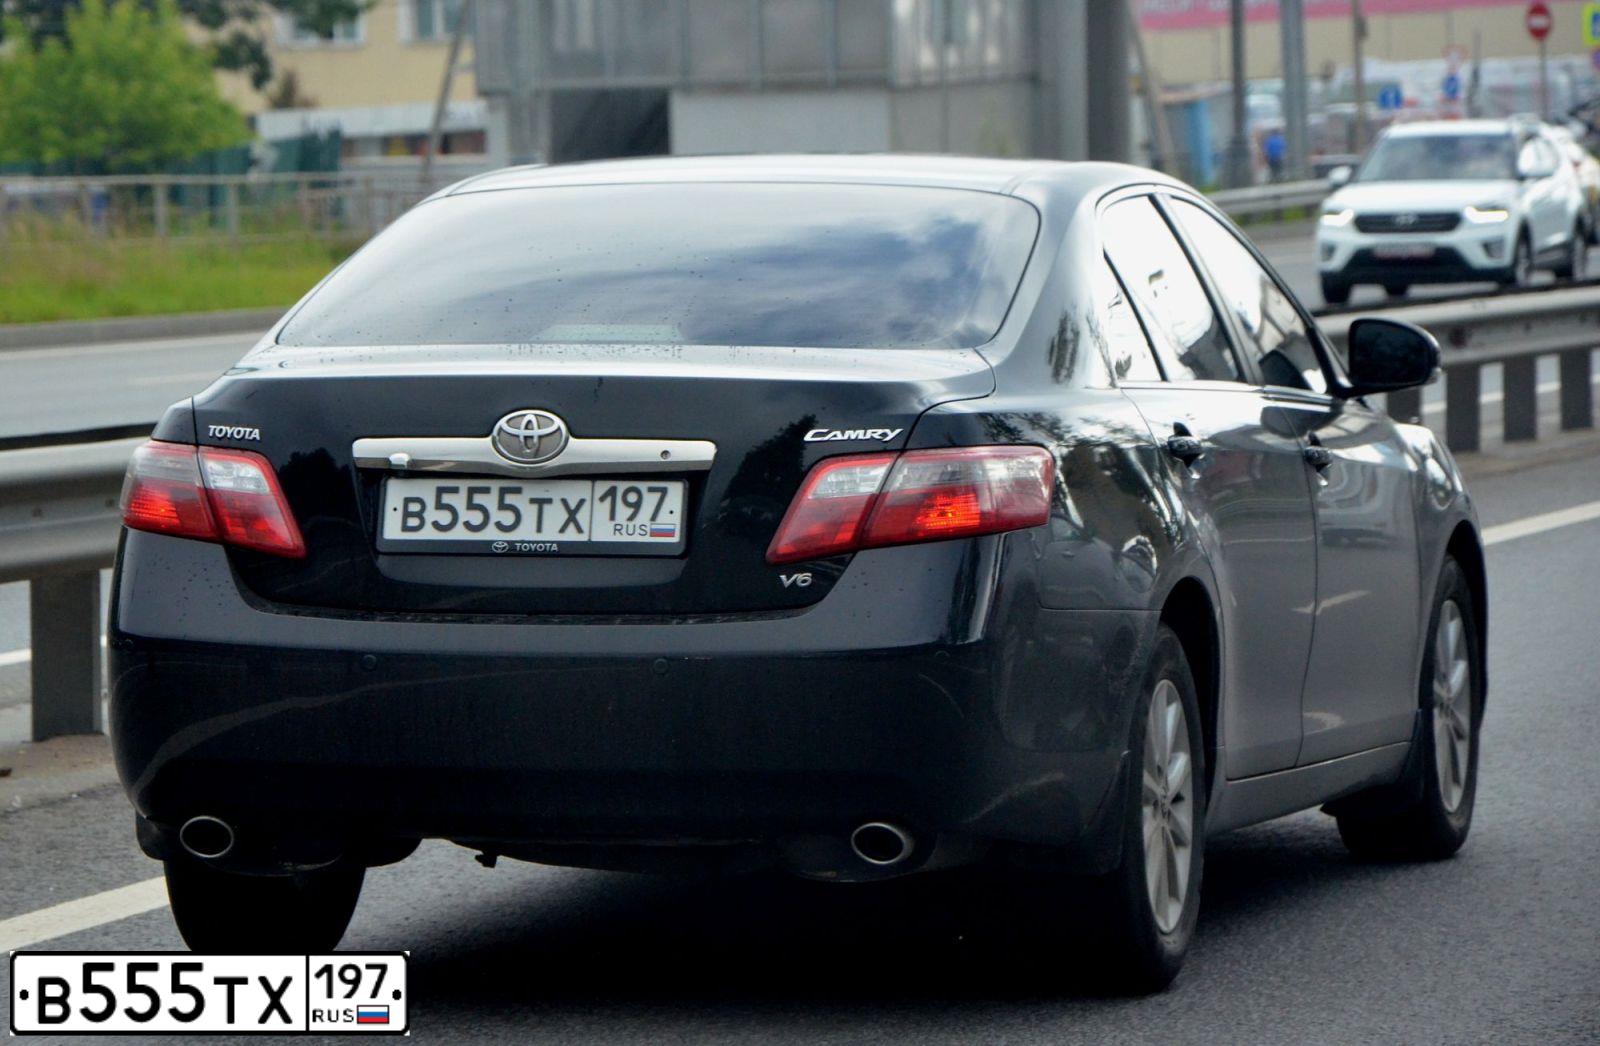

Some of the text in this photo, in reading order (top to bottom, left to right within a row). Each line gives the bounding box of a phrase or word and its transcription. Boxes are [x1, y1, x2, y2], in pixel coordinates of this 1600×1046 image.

[208, 424, 261, 441] TOYOTA
[803, 428, 904, 441] CAMRY
[599, 486, 668, 522] 197
[613, 523, 648, 536] RUS
[514, 541, 558, 552] TOYOTA
[779, 572, 812, 588] V6
